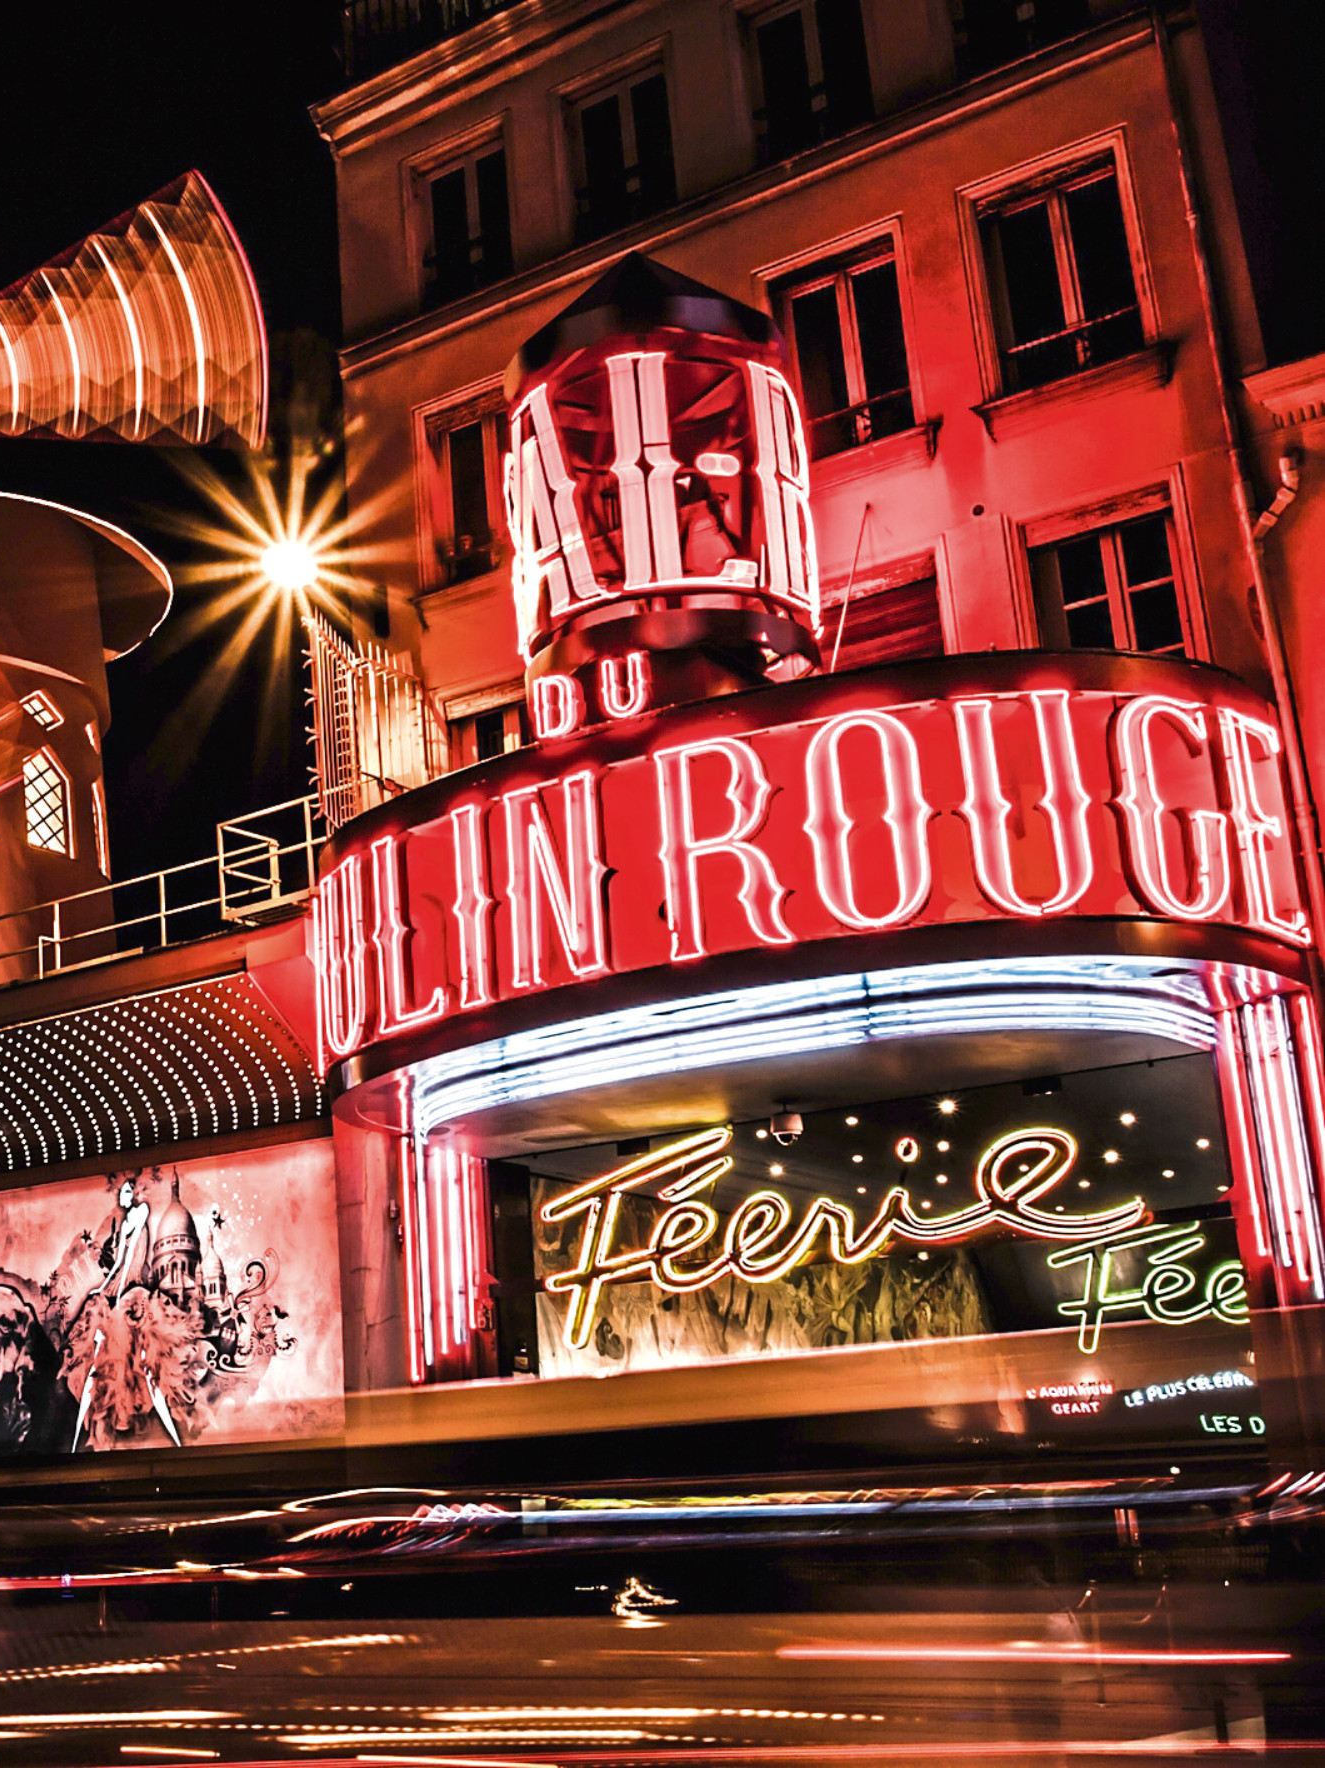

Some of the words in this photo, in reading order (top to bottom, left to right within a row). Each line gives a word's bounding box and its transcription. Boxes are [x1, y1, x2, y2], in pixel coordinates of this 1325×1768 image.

[532, 651, 650, 738] DU
[310, 770, 614, 1077] ULIN
[653, 687, 1312, 961] ROUGE
[1124, 1389, 1144, 1408] LE
[1146, 1384, 1187, 1402] PLUS
[1200, 1414, 1242, 1434] LES
